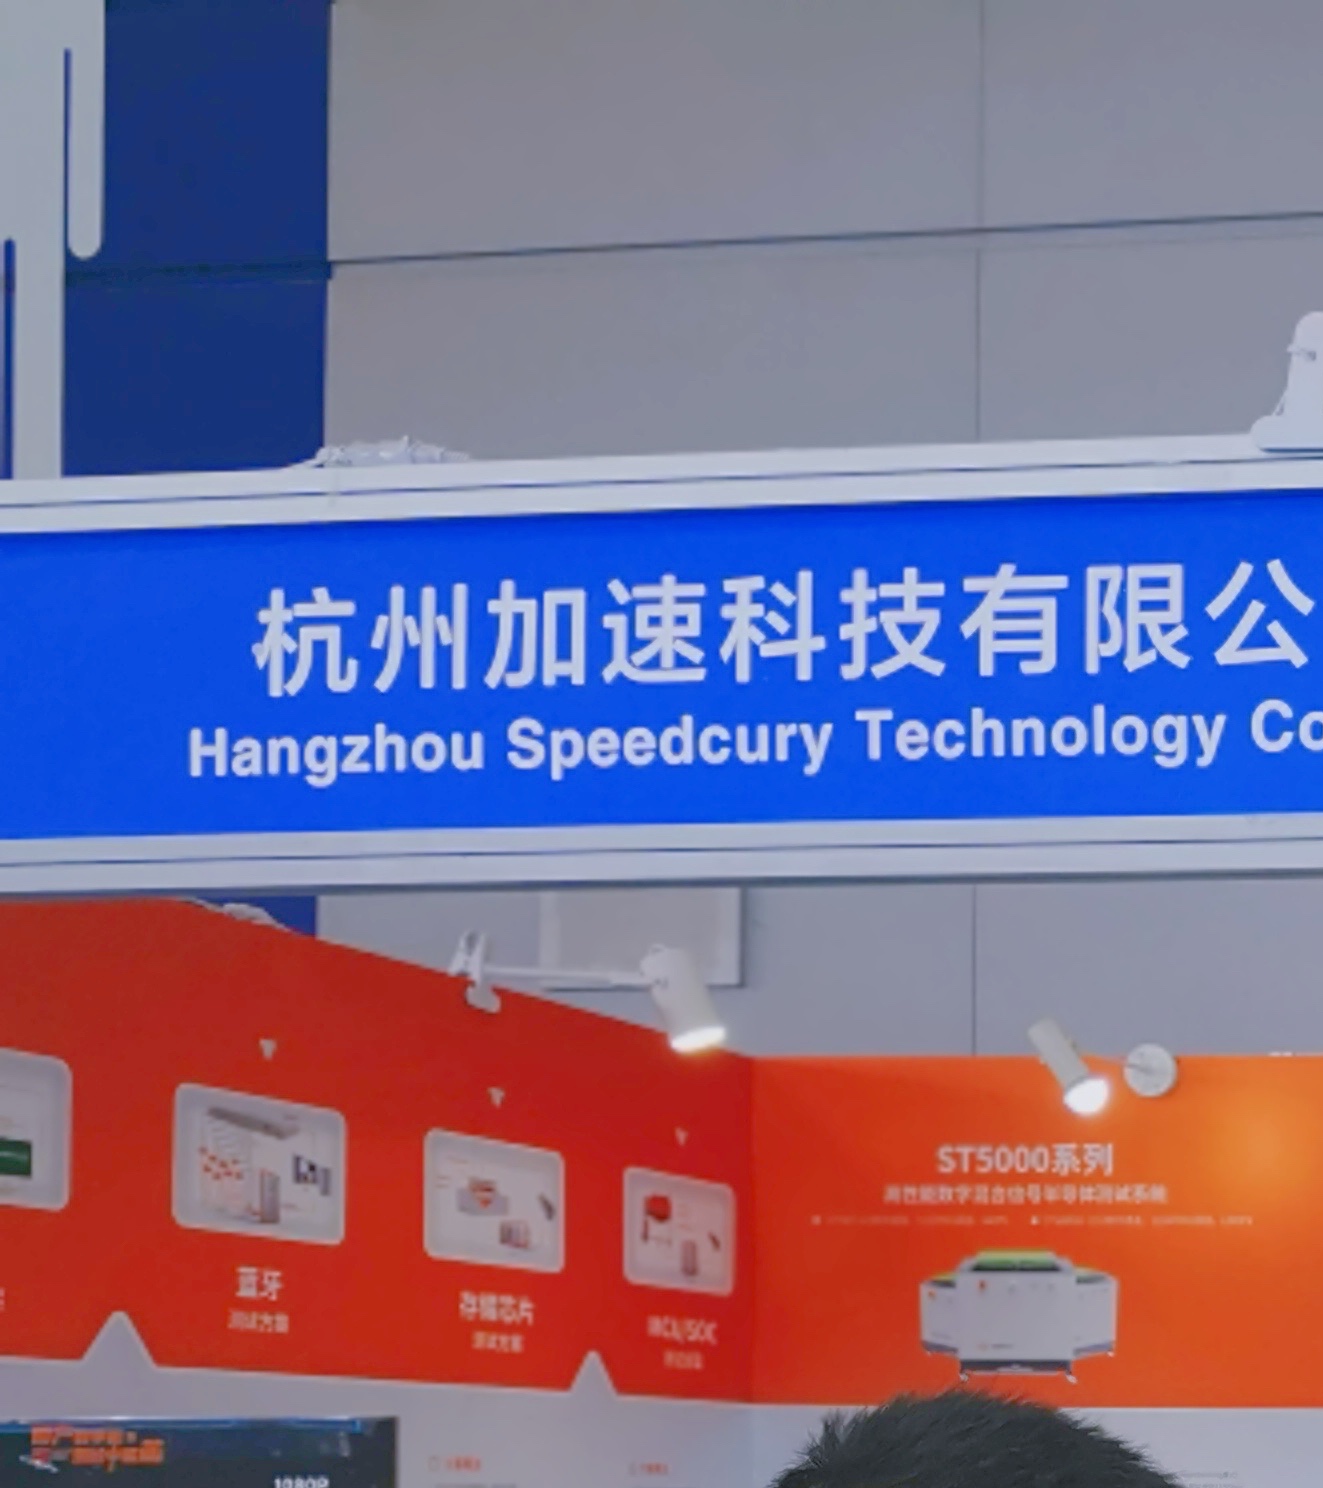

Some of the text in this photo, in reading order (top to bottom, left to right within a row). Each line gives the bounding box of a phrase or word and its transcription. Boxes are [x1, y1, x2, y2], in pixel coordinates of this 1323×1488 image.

[188, 722, 485, 787] Hangzhou
[506, 714, 834, 780] Speedcury
[855, 703, 1227, 769] Technology
[936, 1143, 1114, 1176] ST5000系列
